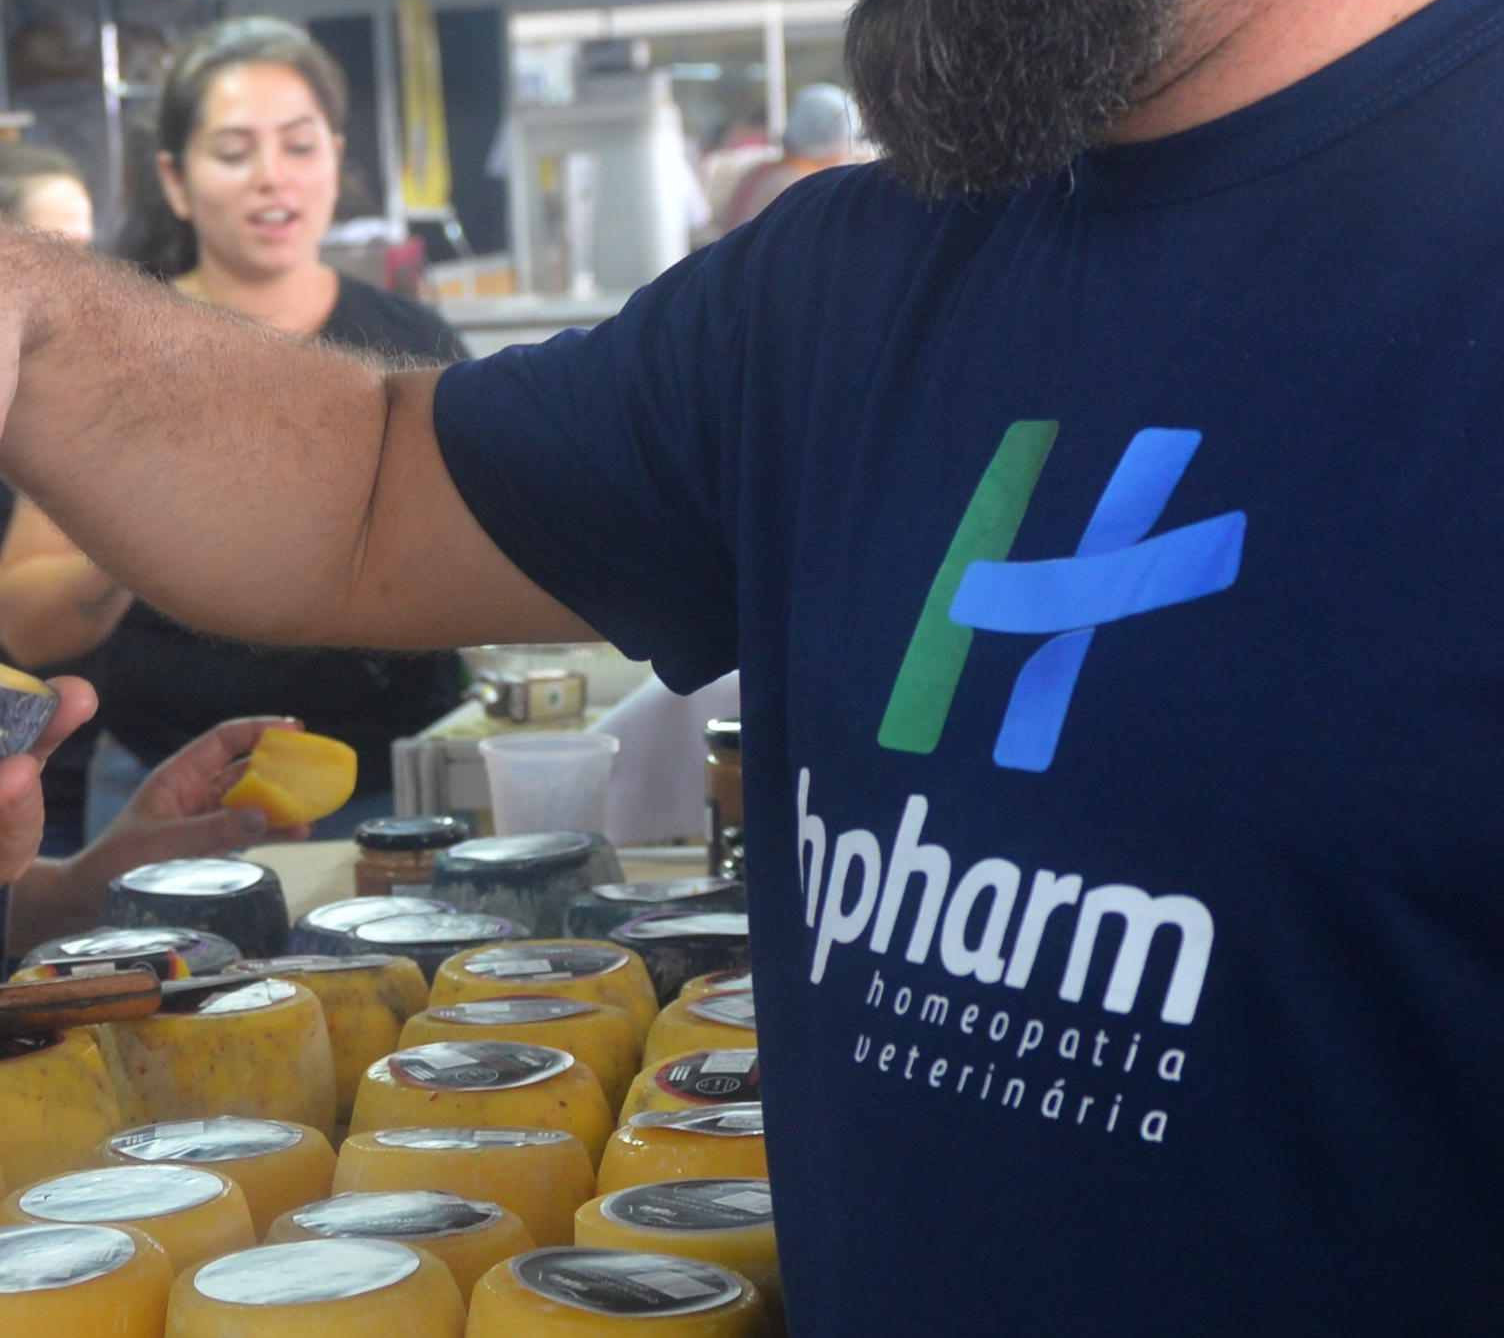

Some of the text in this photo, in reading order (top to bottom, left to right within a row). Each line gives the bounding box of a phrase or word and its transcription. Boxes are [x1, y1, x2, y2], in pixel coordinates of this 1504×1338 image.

[796, 766, 1215, 1026] hpharm
[866, 969, 1186, 1082] homeopatia
[854, 1033, 1168, 1143] veterinária
